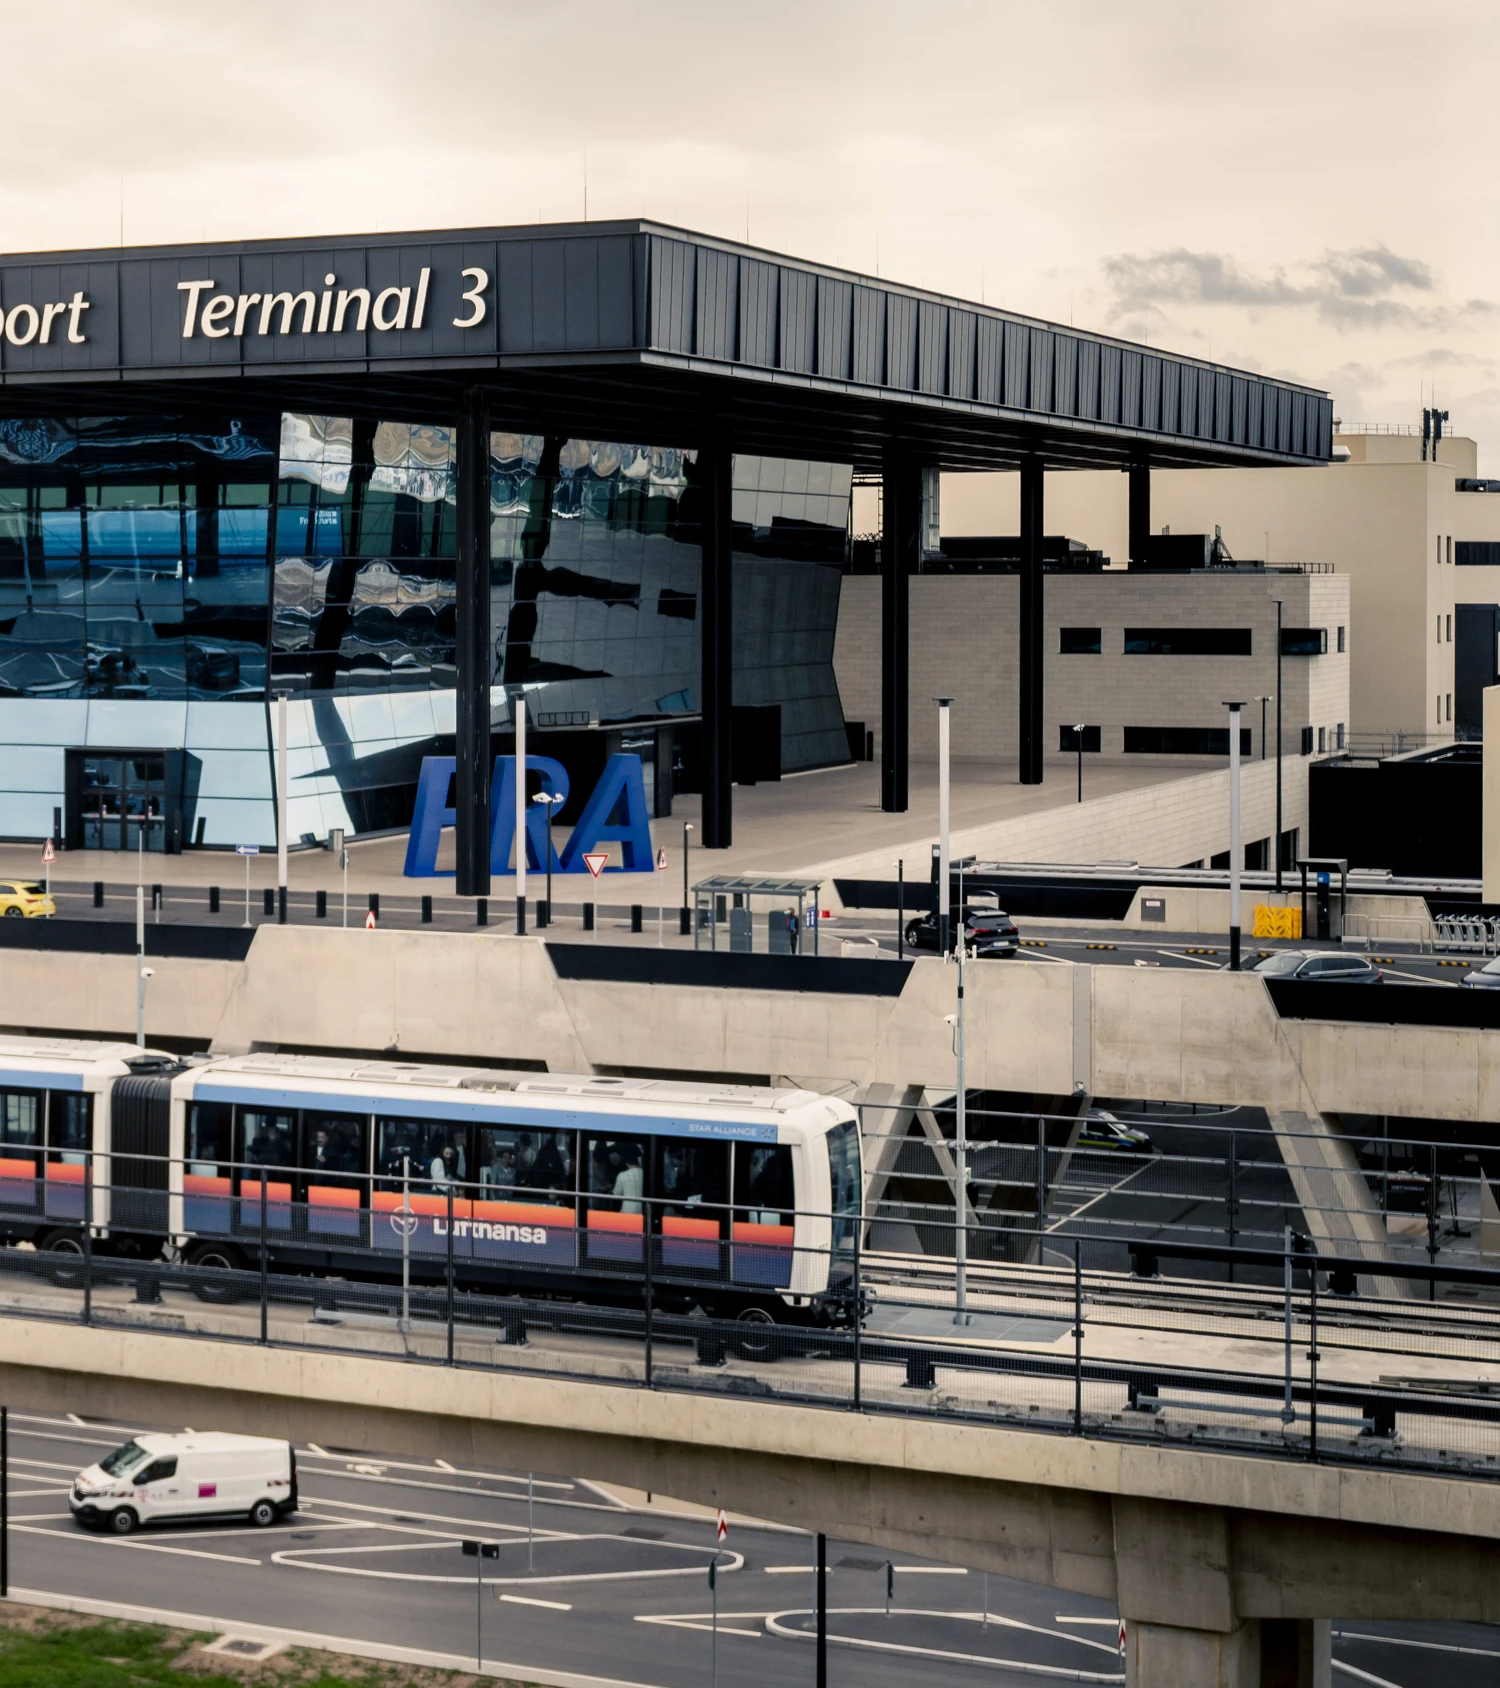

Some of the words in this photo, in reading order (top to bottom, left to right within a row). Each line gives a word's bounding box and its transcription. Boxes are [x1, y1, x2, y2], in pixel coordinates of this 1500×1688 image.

[177, 267, 431, 338] Terminal
[452, 267, 489, 328] 3
[688, 1123, 712, 1133] STAR
[713, 1125, 757, 1137] ALLIANCE
